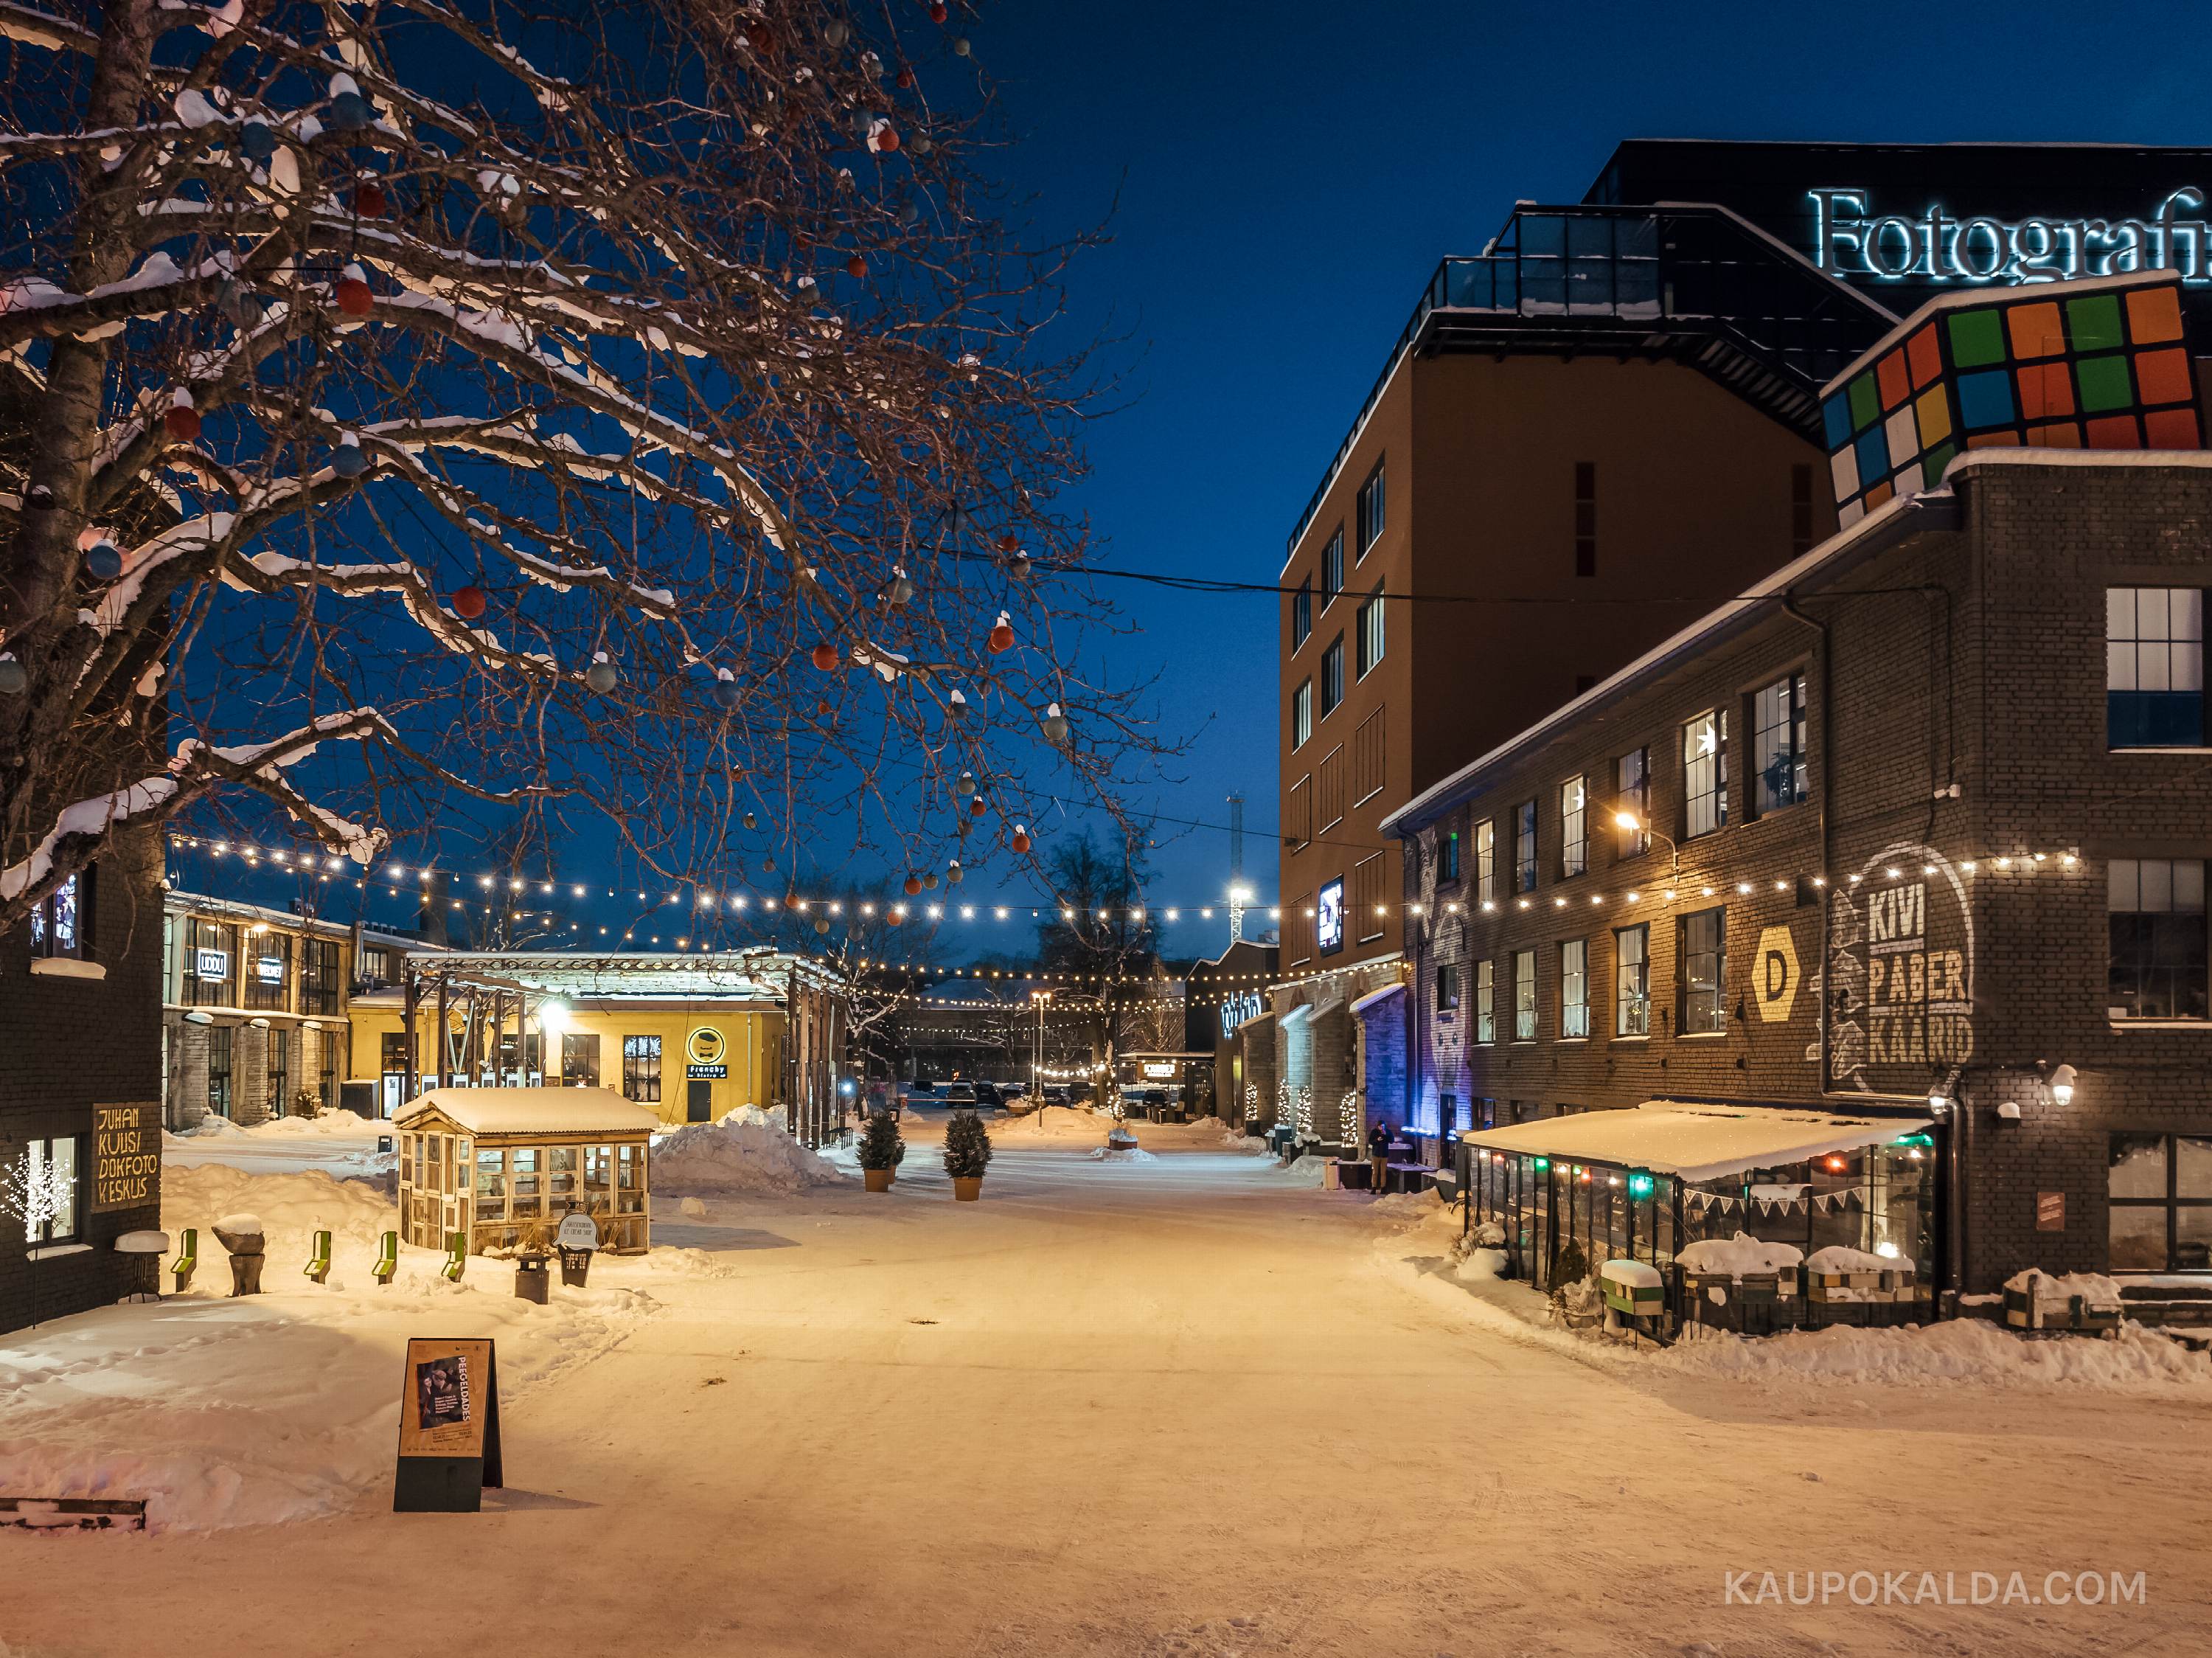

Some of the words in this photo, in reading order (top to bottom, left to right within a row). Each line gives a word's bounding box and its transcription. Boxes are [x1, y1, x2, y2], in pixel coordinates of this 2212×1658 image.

[1868, 884, 1924, 942] KIVI
[1766, 949, 1788, 1002] D
[1868, 950, 1966, 1006] PABER
[690, 1066, 725, 1074] Frenchy
[98, 1108, 139, 1131] JUHAN
[98, 1131, 142, 1156] KUUSI
[99, 1154, 157, 1179] DOKFOTO
[99, 1177, 147, 1204] KESKUS
[458, 1356, 470, 1422] PEEGELDADES
